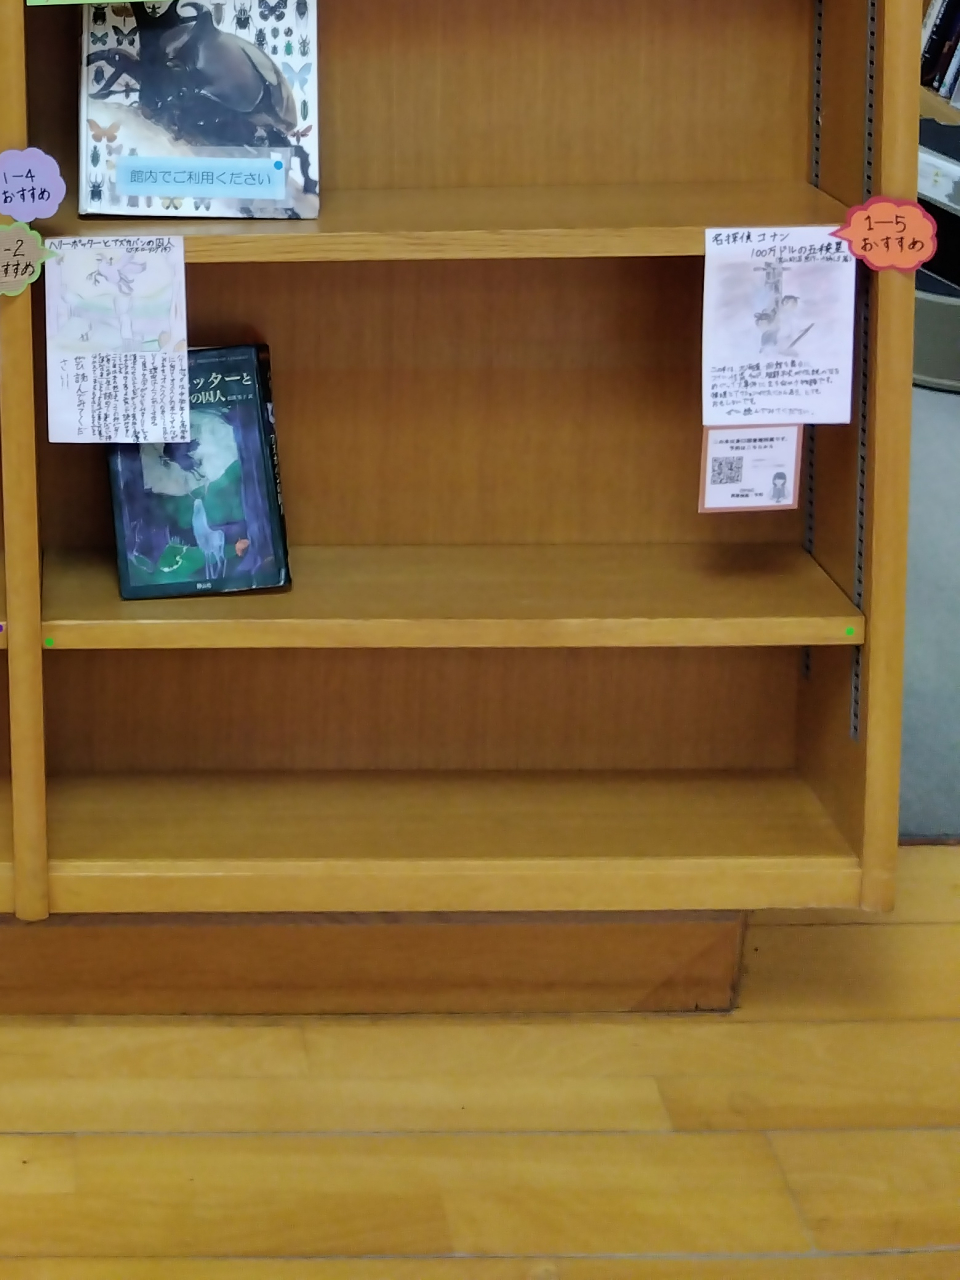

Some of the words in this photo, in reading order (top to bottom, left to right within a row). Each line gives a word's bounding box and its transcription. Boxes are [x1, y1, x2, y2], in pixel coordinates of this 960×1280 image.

[3, 170, 36, 185] 1-4
[129, 168, 271, 186] 館内でご利用ください
[1, 187, 52, 205] おすすめ
[864, 215, 908, 234] 1-5
[860, 237, 925, 254] おすすめ
[192, 371, 253, 390] ッターと
[190, 389, 227, 404] の囚人
